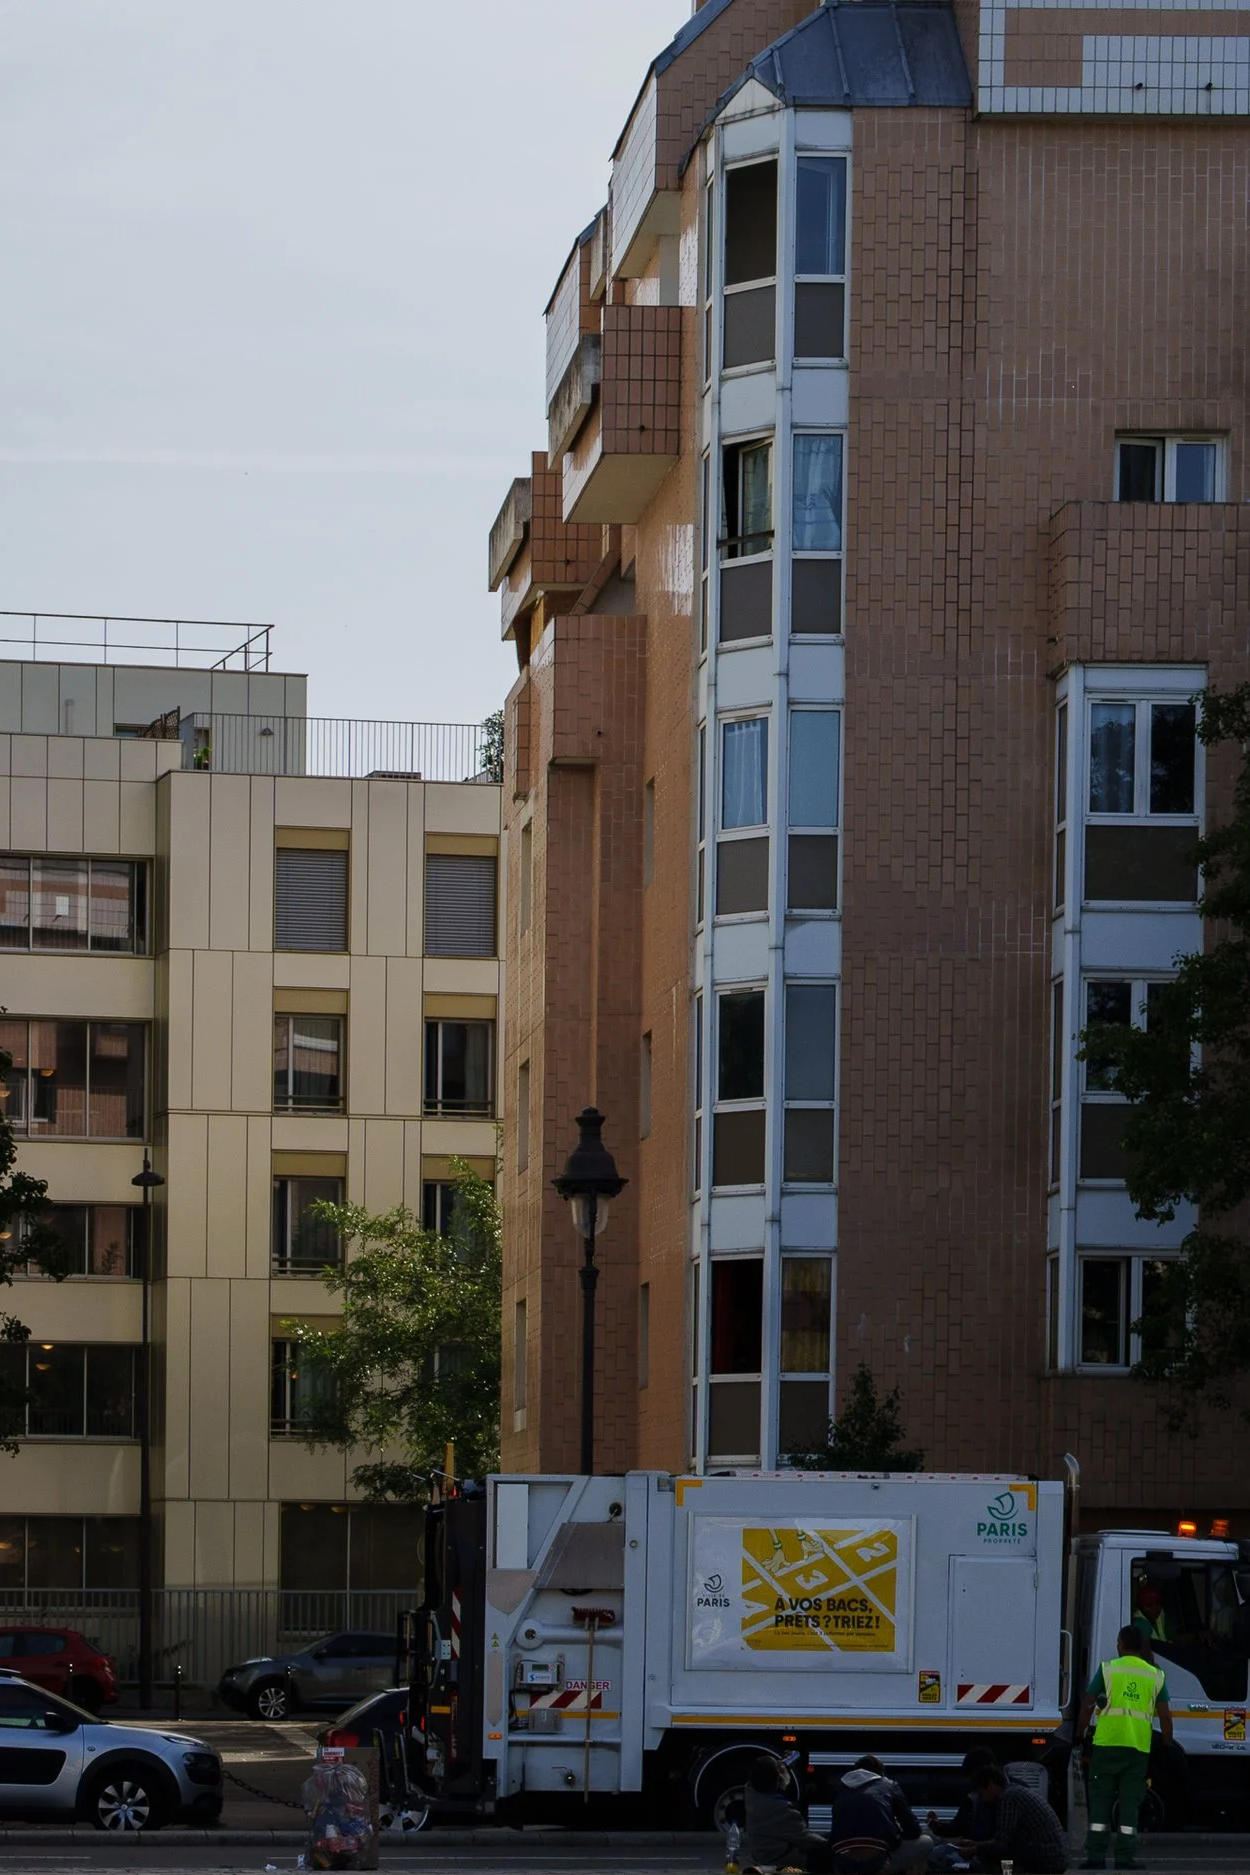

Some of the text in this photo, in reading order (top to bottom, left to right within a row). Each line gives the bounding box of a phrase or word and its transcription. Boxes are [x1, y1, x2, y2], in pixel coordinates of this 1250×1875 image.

[977, 1523, 1028, 1537] PARIS
[697, 1598, 730, 1607] PARIS
[789, 1598, 823, 1611] VOS
[826, 1598, 873, 1614] BACS,
[565, 1681, 610, 1690] DANGER
[1122, 1691, 1141, 1700] PARIS
